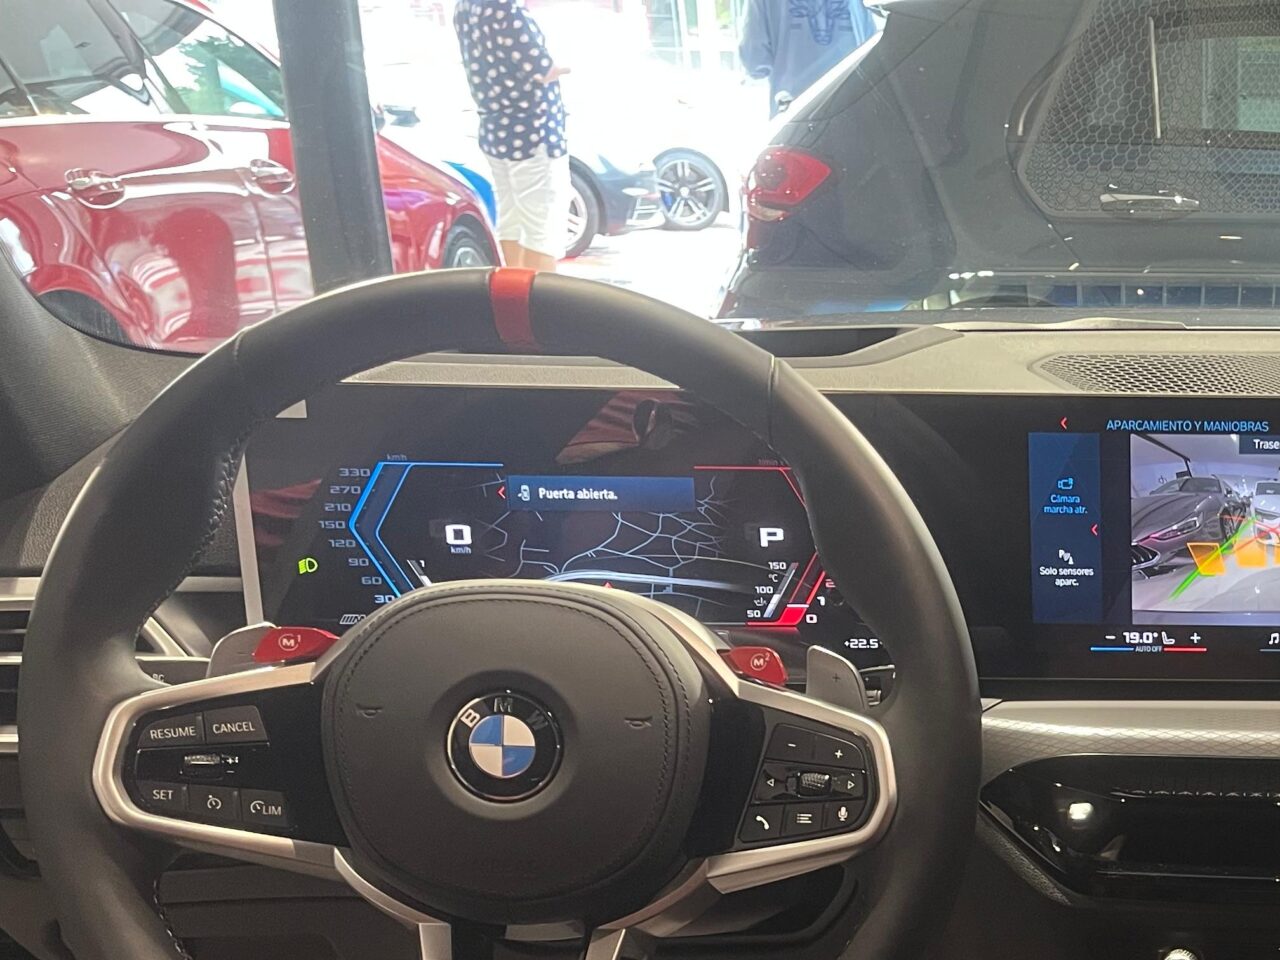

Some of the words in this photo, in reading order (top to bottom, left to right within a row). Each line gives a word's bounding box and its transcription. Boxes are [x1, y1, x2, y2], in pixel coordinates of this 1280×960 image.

[1106, 419, 1192, 432] APARCAMIENTO
[1194, 420, 1202, 431] Y
[1203, 420, 1269, 433] MANIOBRAS
[339, 468, 371, 477] 330
[330, 486, 361, 494] 270
[538, 487, 575, 500] Puerta
[577, 487, 618, 500] abierta.
[1050, 493, 1080, 504] Cámara
[325, 503, 351, 512] 210
[1043, 505, 1073, 514] marcha
[1074, 505, 1088, 514] atr.
[318, 521, 346, 529] 150
[445, 524, 472, 545] 0
[759, 527, 784, 547] P
[328, 540, 356, 548] 120
[450, 546, 472, 554] km/h
[348, 558, 369, 566] 90
[768, 562, 787, 570] 150
[1039, 566, 1057, 576] Solo
[1058, 567, 1094, 577] sensores
[361, 577, 382, 585] 60
[1055, 577, 1079, 587] aparc.
[755, 586, 774, 594] 100
[374, 595, 395, 603] 30
[746, 609, 761, 618] 50
[212, 721, 255, 734] CANCEL
[150, 726, 197, 740] RESUME
[152, 789, 174, 800] SET
[262, 803, 282, 815] LIM
